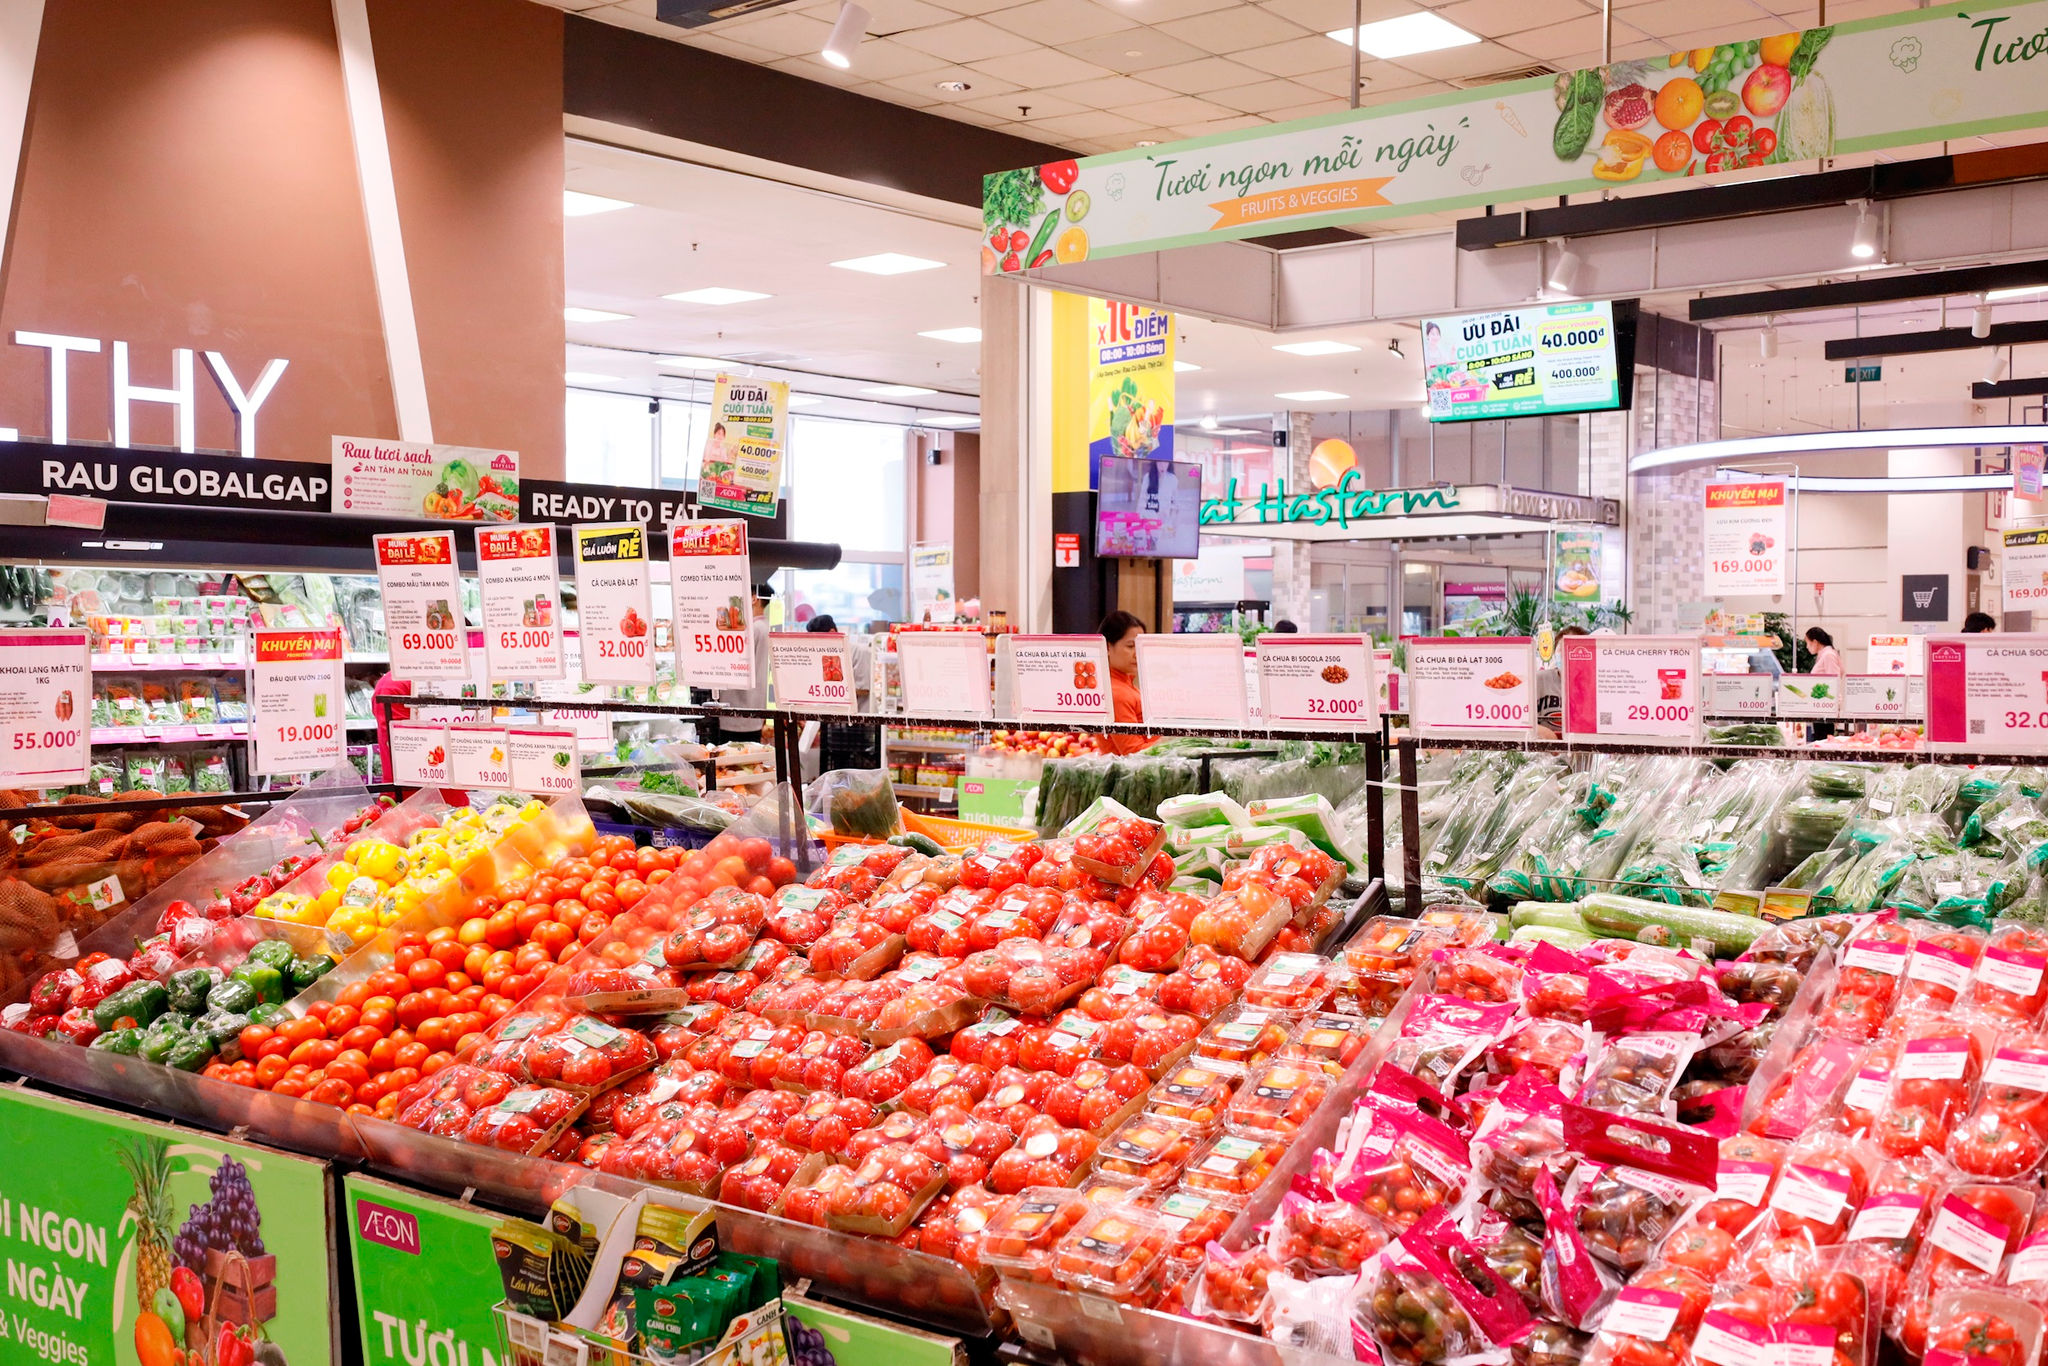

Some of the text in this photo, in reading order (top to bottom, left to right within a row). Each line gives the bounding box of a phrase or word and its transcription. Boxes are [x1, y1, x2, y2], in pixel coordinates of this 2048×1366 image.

[1154, 124, 1459, 201] Tươi ngon mỗi ngày
[1240, 187, 1358, 217] FRUITS & VEGGIES
[1135, 312, 1168, 339] ĐIỂM
[1463, 314, 1520, 341] ƯU ĐÃI
[1492, 333, 1532, 353] TUẦN
[1541, 328, 1605, 348] 40.000đ
[1552, 366, 1600, 379] 400.000đ
[0, 330, 289, 457] THY
[730, 387, 768, 402] ƯU ĐÃI
[723, 401, 773, 415] CUỐI TUẦN
[342, 441, 433, 467] Rau tươi sạch
[364, 465, 376, 473] AN
[398, 467, 409, 475] AN
[43, 460, 117, 490] RAU
[129, 465, 328, 502] GLOBALGAP
[1710, 486, 1778, 501] KHUYẾN MẠI
[532, 492, 703, 523] READY TO EAT
[583, 529, 641, 558] GIÁ LUÔN RẺ
[262, 636, 336, 652] KHUYẾN MẠI
[403, 633, 458, 650] 69.000đ
[501, 631, 553, 648] 65.000đ
[599, 640, 648, 657] 32.000đ
[2001, 649, 2027, 657] CHUA
[0, 666, 27, 675] KHOAI
[28, 666, 49, 674] LANG
[72, 663, 83, 672] TÚI
[1470, 656, 1482, 665] LẠT
[1308, 699, 1363, 713] 32.000đ
[1466, 704, 1529, 719] 19.000đ
[1628, 705, 1694, 721] 29.000đ
[13, 730, 81, 750] 55.000đ
[278, 724, 337, 742] 19.000đ
[479, 771, 508, 783] 19.000
[20, 1203, 107, 1268] NGON
[8, 1258, 88, 1321] NGÀY
[757, 1310, 777, 1326] CANH
[13, 1313, 88, 1366] Veggies
